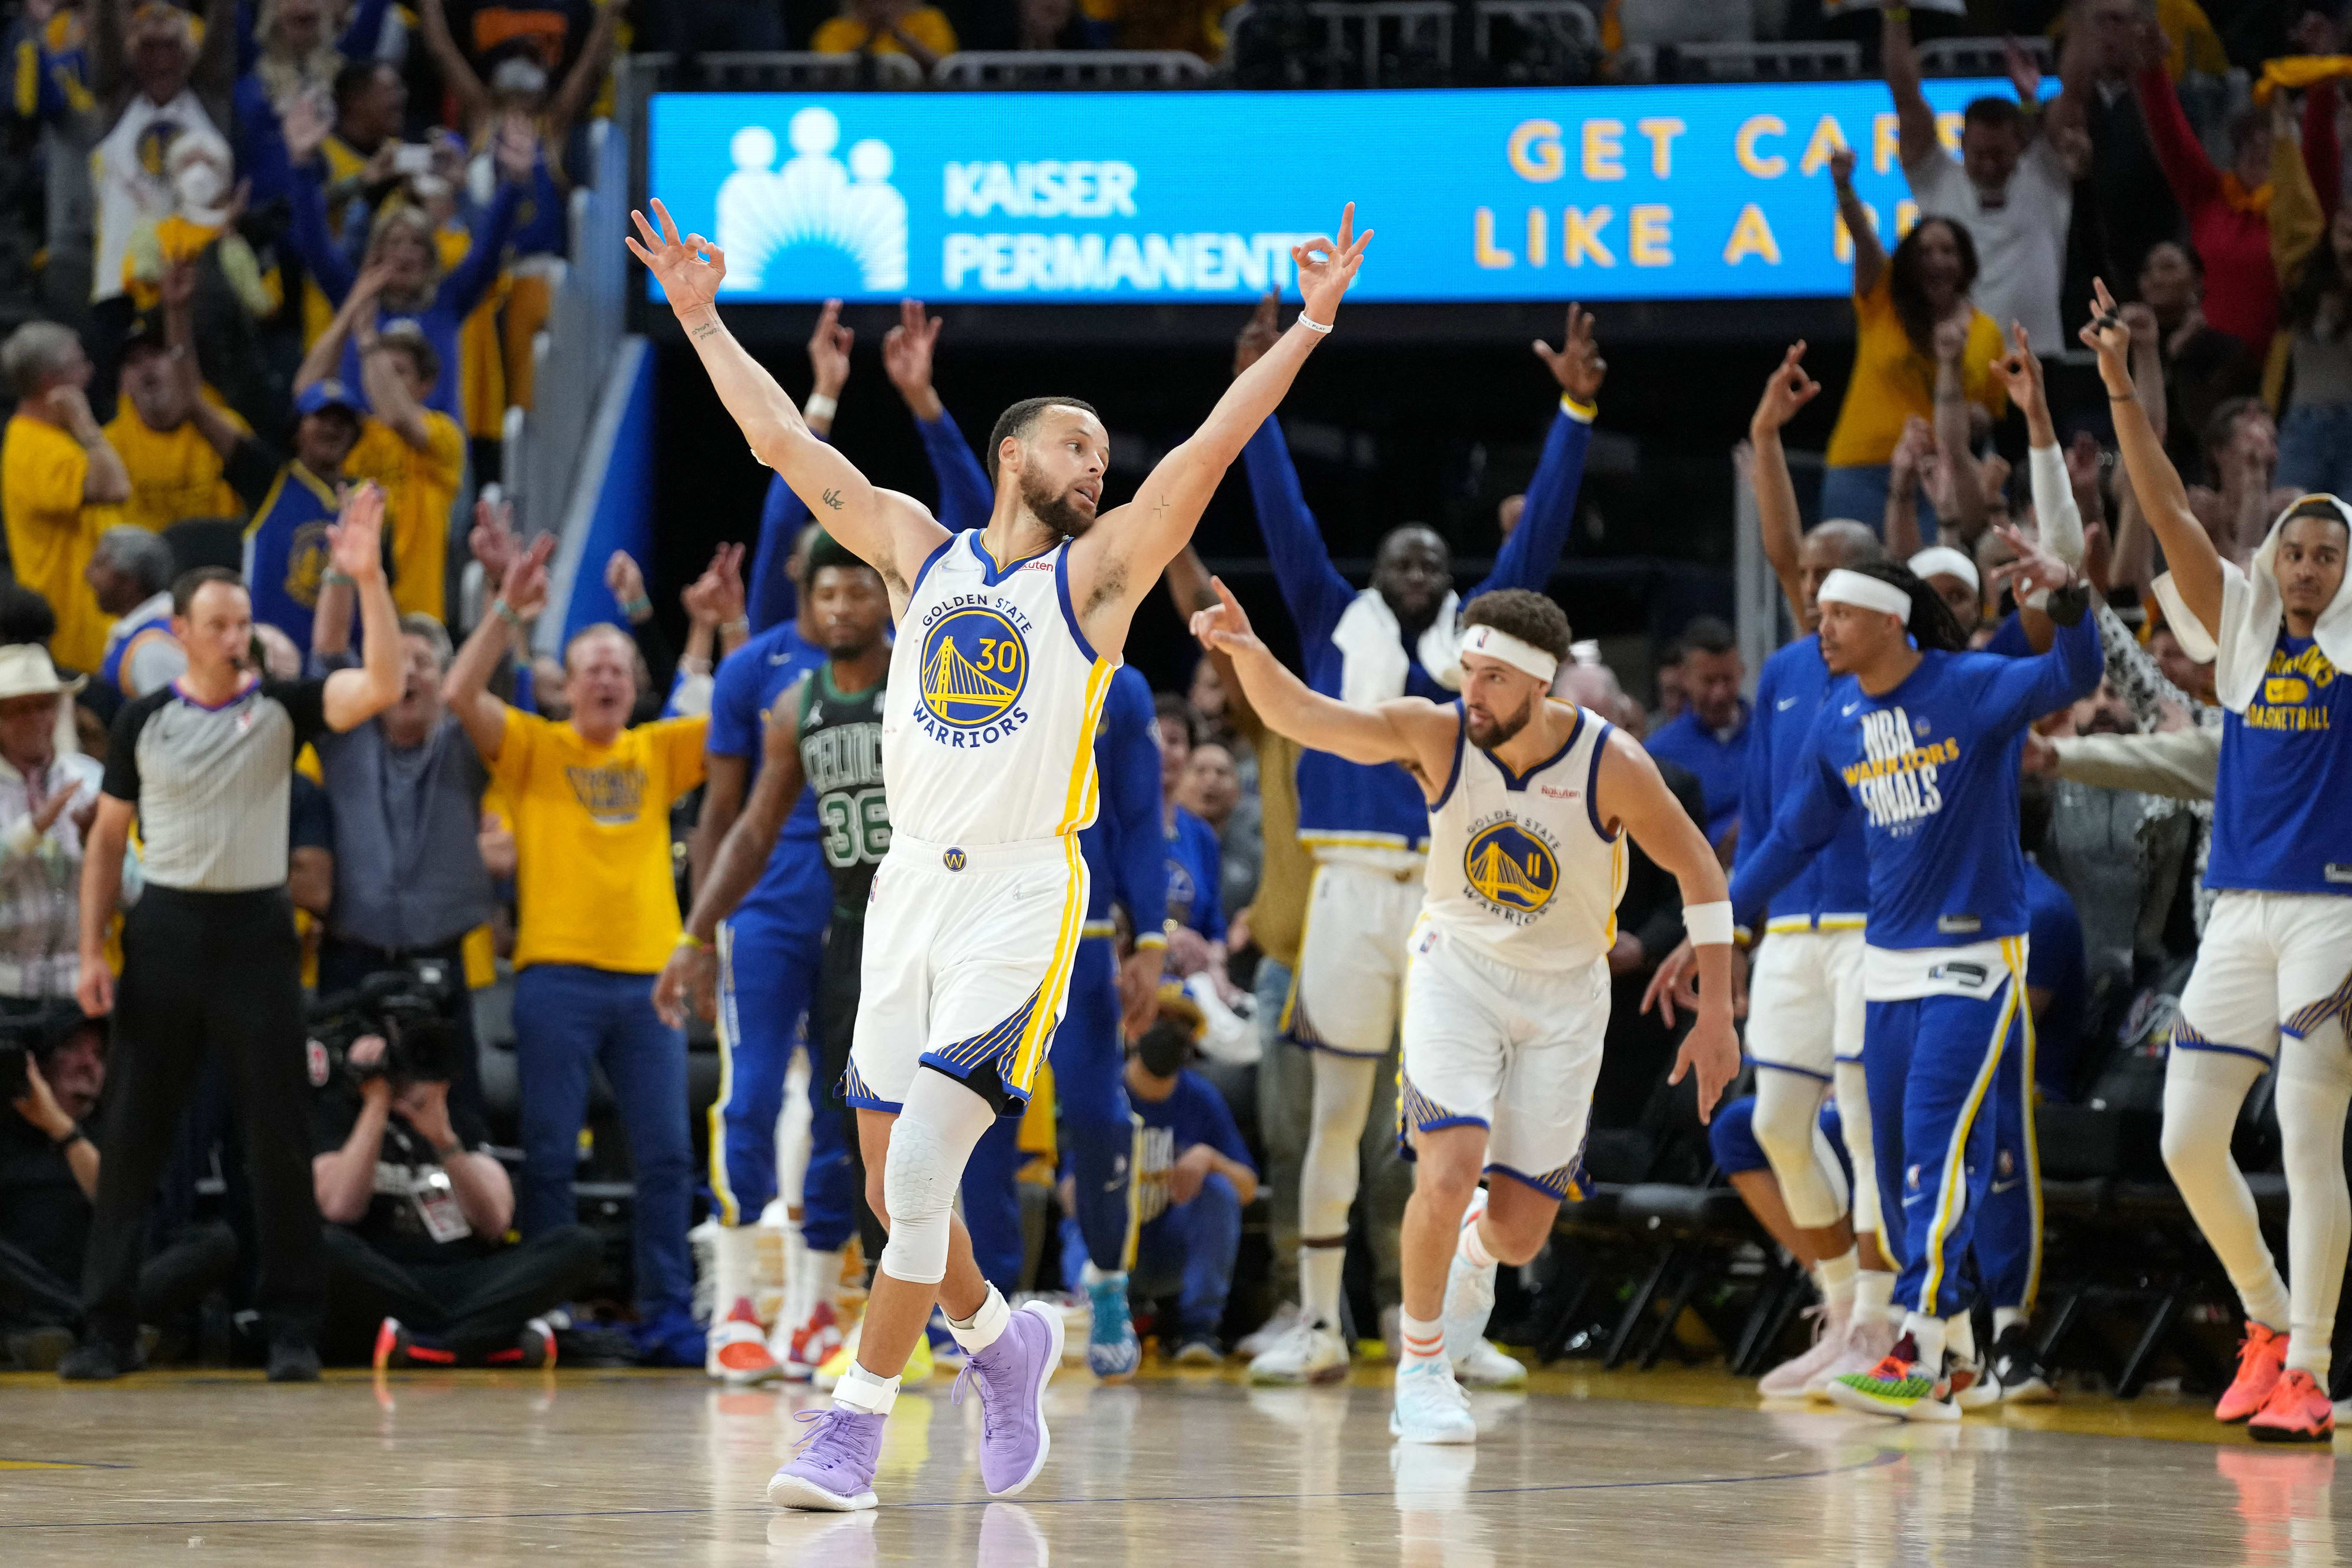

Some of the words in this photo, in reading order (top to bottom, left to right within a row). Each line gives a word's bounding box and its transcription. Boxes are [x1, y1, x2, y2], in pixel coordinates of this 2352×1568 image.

[1508, 116, 1687, 183] GET
[943, 160, 1138, 218] KAISER
[1475, 203, 1675, 269] LIKE
[1723, 202, 1782, 266] A
[943, 233, 1359, 290] PERMANENT
[923, 594, 988, 627] GOLDEN
[995, 597, 1033, 634] STATE
[976, 638, 1017, 673] 30
[913, 699, 1028, 748] WARRIORS
[1861, 706, 1916, 767] NBA
[1842, 737, 1960, 788] WARRIORS
[1541, 785, 1581, 798] Rakuten
[1859, 763, 1943, 828] FINALS
[1525, 817, 1561, 850] STATE
[1526, 851, 1541, 880] 11
